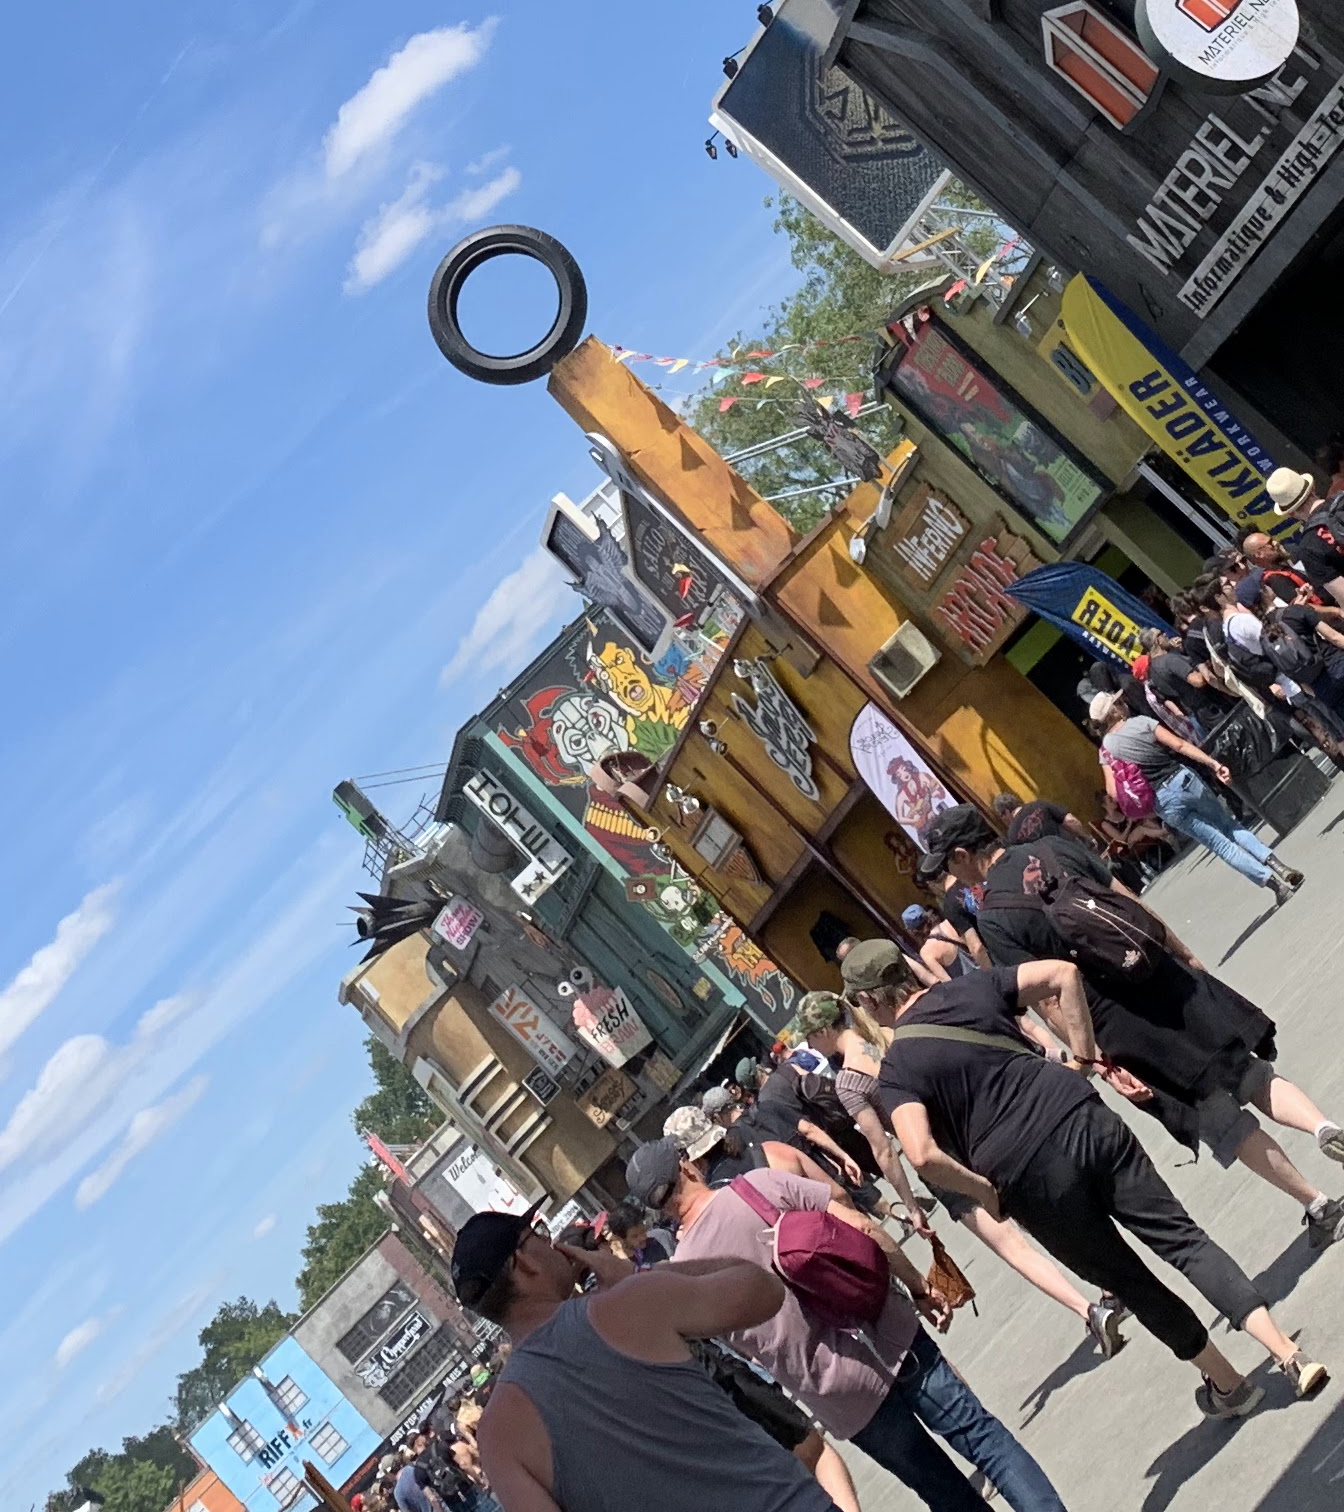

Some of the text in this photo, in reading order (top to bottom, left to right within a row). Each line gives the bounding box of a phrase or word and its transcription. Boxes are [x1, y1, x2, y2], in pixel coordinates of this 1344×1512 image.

[1183, 204, 1274, 312] Informatique
[1264, 185, 1288, 206] &
[1184, 375, 1273, 473] WORKWEAR
[470, 774, 570, 876] HOTEL
[590, 997, 630, 1043] FRESH
[389, 1428, 406, 1447] JUST
